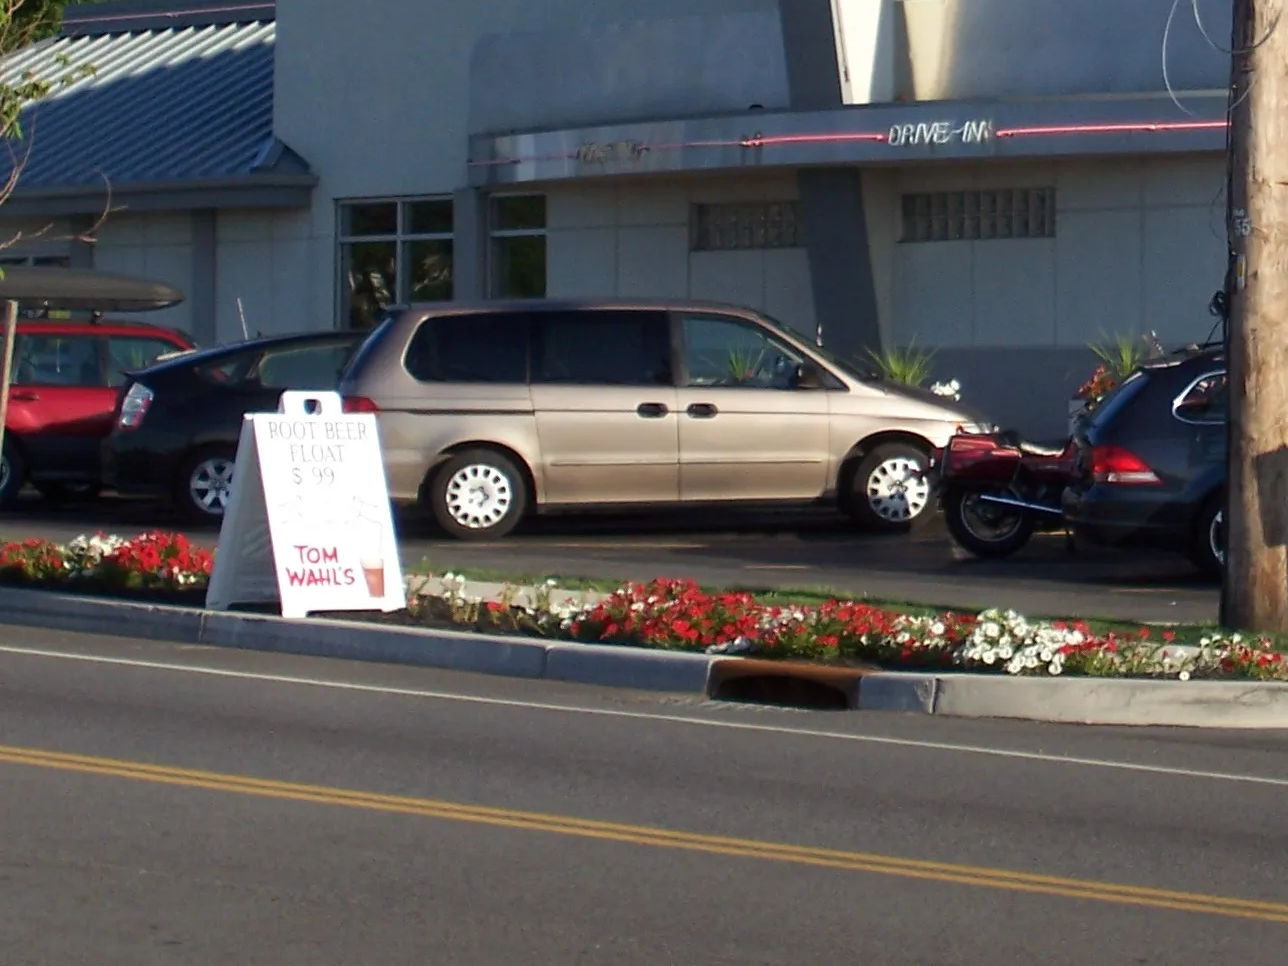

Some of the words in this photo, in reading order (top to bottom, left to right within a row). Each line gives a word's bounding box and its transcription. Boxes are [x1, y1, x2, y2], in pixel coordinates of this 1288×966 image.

[268, 420, 316, 440] ROOT
[324, 421, 367, 440] BEER
[289, 443, 345, 462] FLOAT
[293, 545, 339, 564] TOM
[285, 567, 355, 587] WAHL'S
